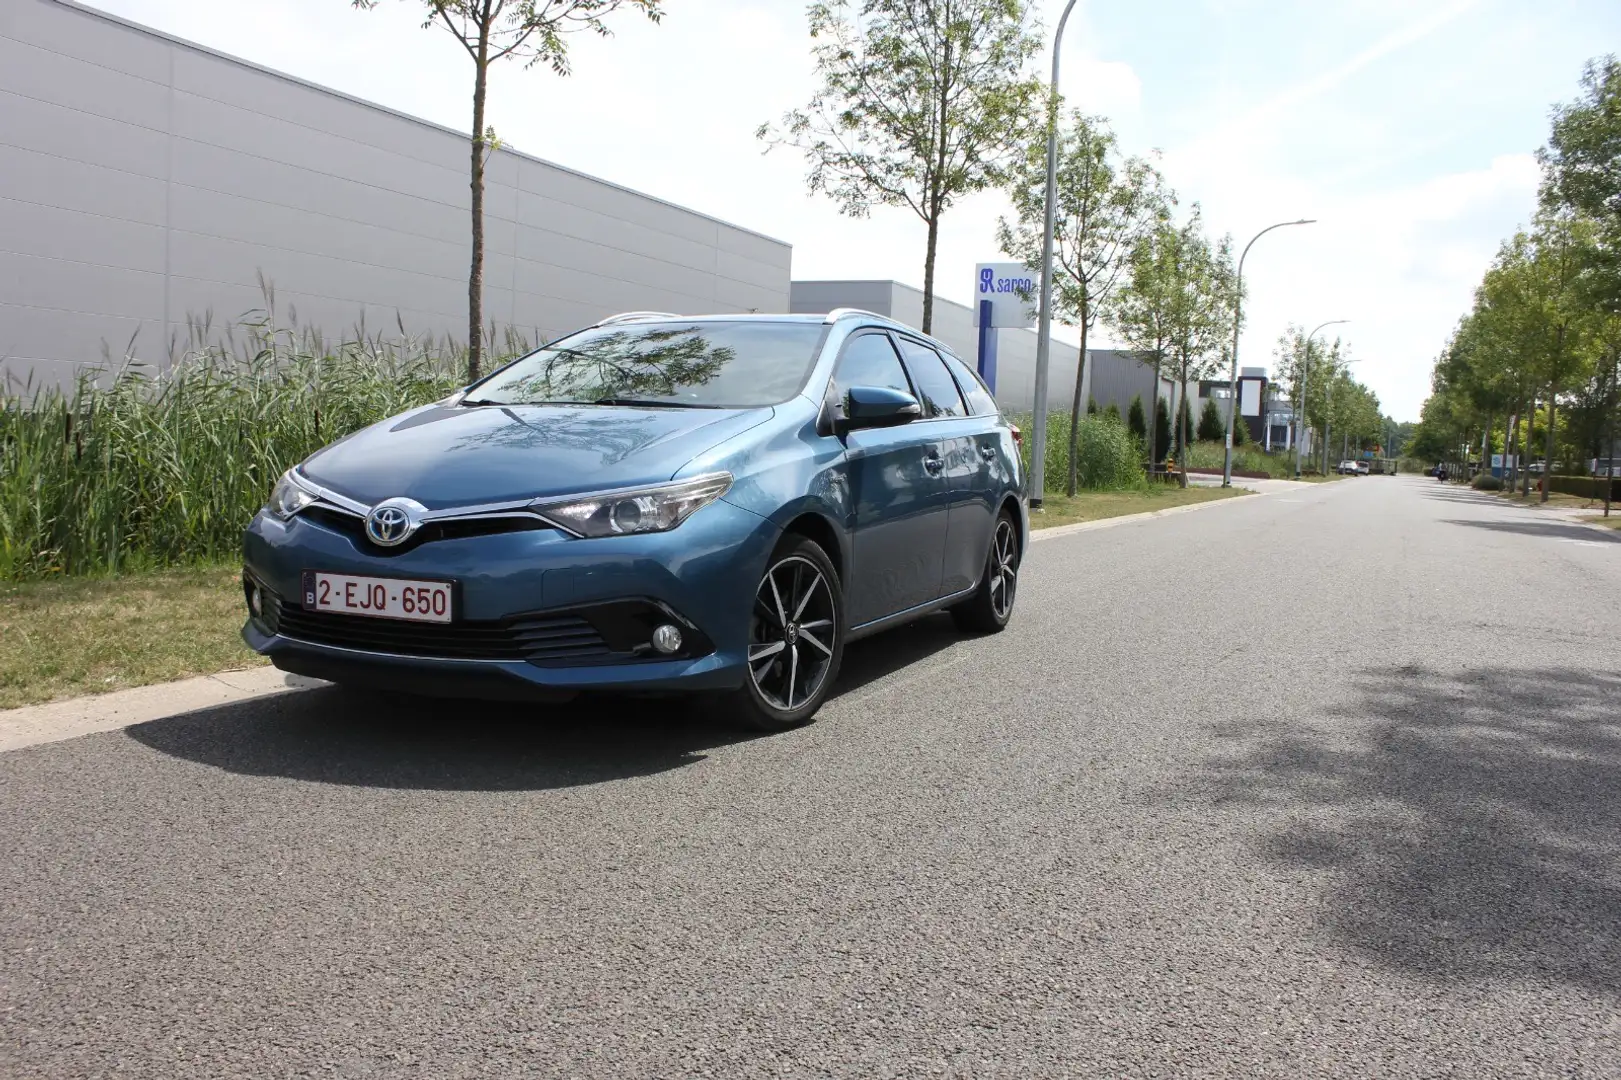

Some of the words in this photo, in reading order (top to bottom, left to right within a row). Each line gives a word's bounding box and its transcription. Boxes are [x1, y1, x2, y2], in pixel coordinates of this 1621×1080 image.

[997, 278, 1031, 293] sarco
[306, 592, 314, 604] B
[319, 579, 446, 616] 2-EJQ-650
